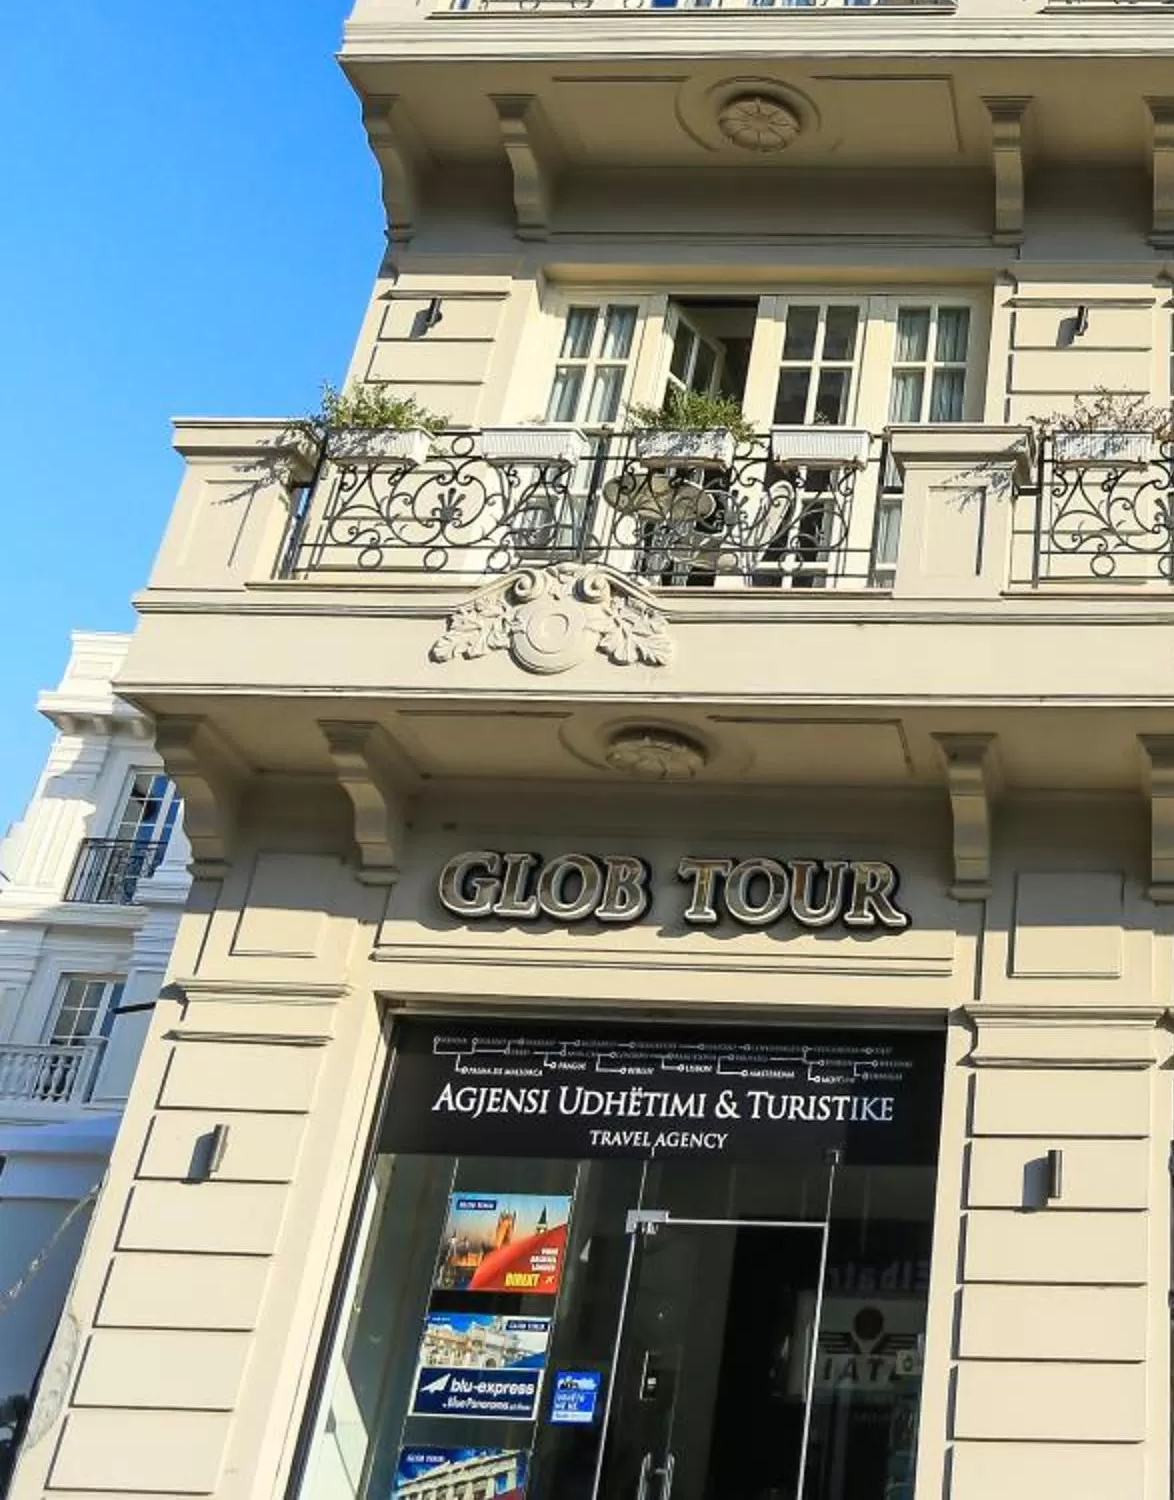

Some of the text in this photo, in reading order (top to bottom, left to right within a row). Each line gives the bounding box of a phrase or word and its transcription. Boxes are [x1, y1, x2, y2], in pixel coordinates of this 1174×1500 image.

[438, 851, 908, 926] GLOB TOUR
[431, 1082, 895, 1121] AGJENSI UDHËTIMI & TURISTIKE
[589, 1129, 728, 1149] TRAVEL AGENCY
[450, 1377, 535, 1397] blu-express
